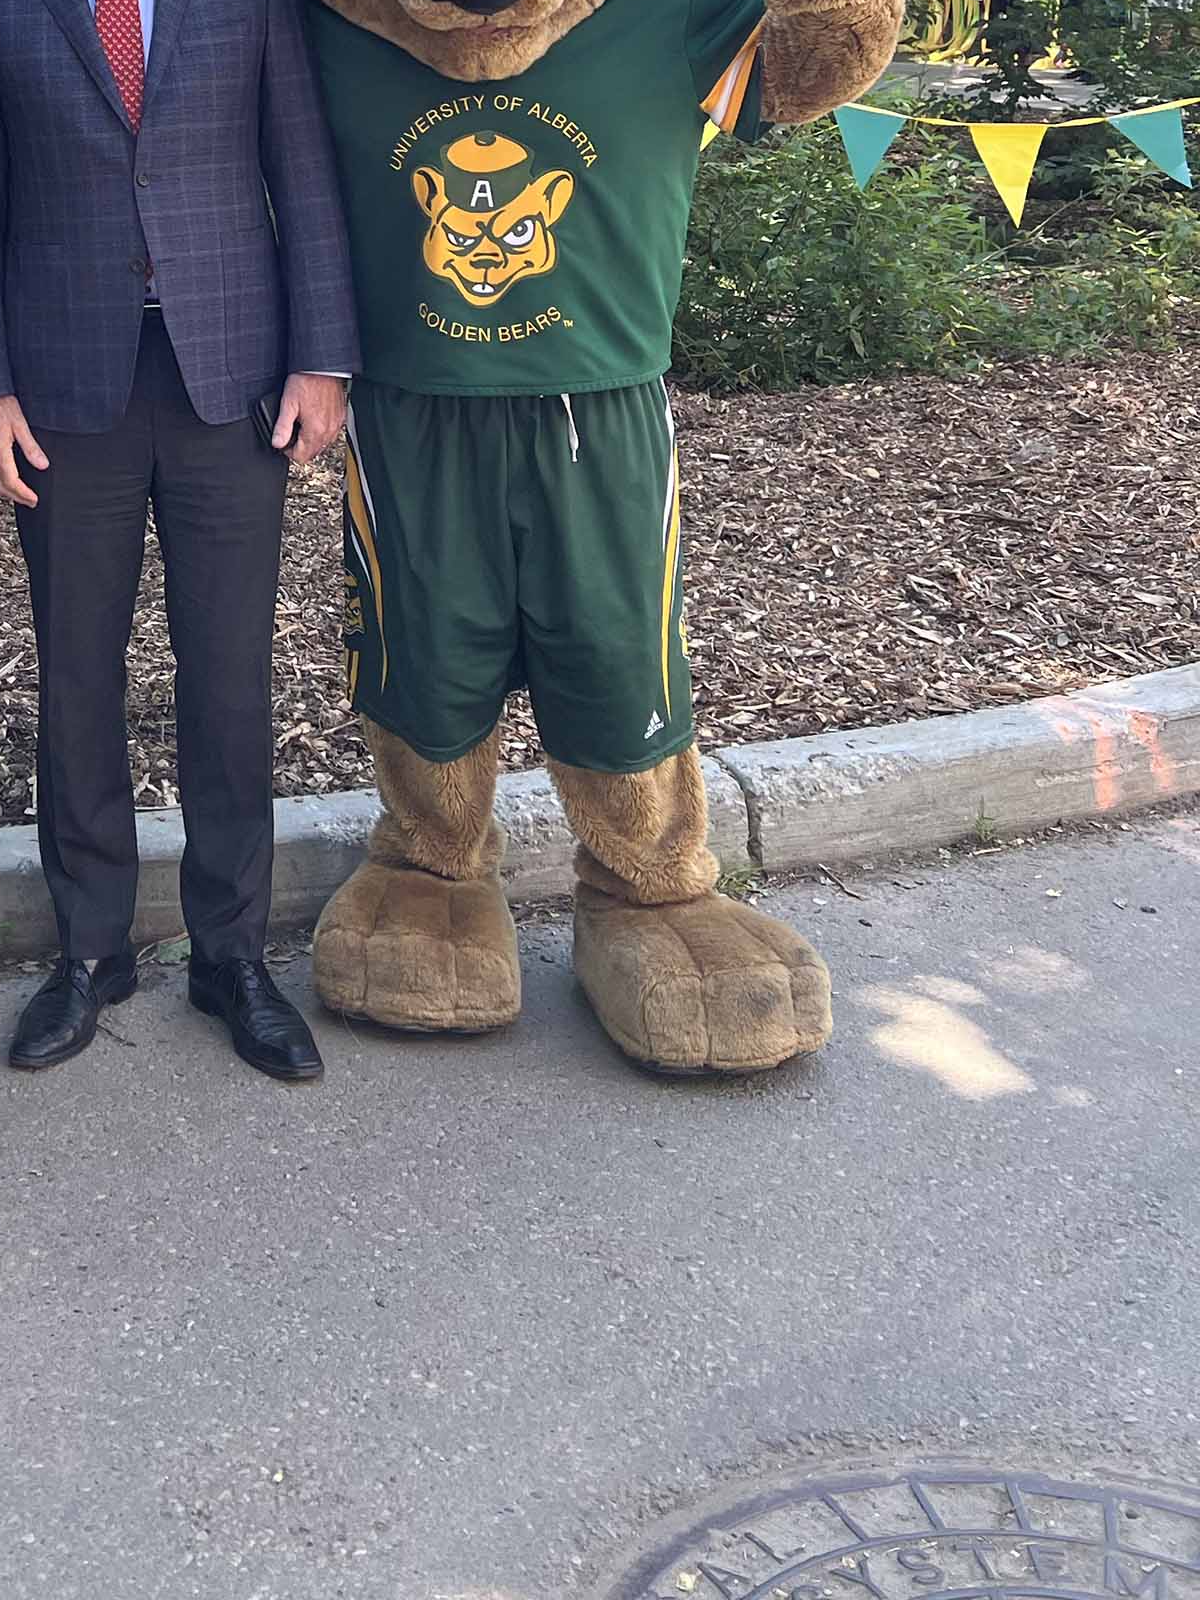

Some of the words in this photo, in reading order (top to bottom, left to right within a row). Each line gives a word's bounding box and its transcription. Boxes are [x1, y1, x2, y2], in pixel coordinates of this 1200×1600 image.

[389, 95, 486, 171] UNIVERSITY
[494, 94, 524, 112] OF
[527, 102, 600, 168] ALBERTA
[470, 180, 495, 208] A
[418, 302, 491, 343] GOLDEN
[498, 306, 561, 342] BEARS
